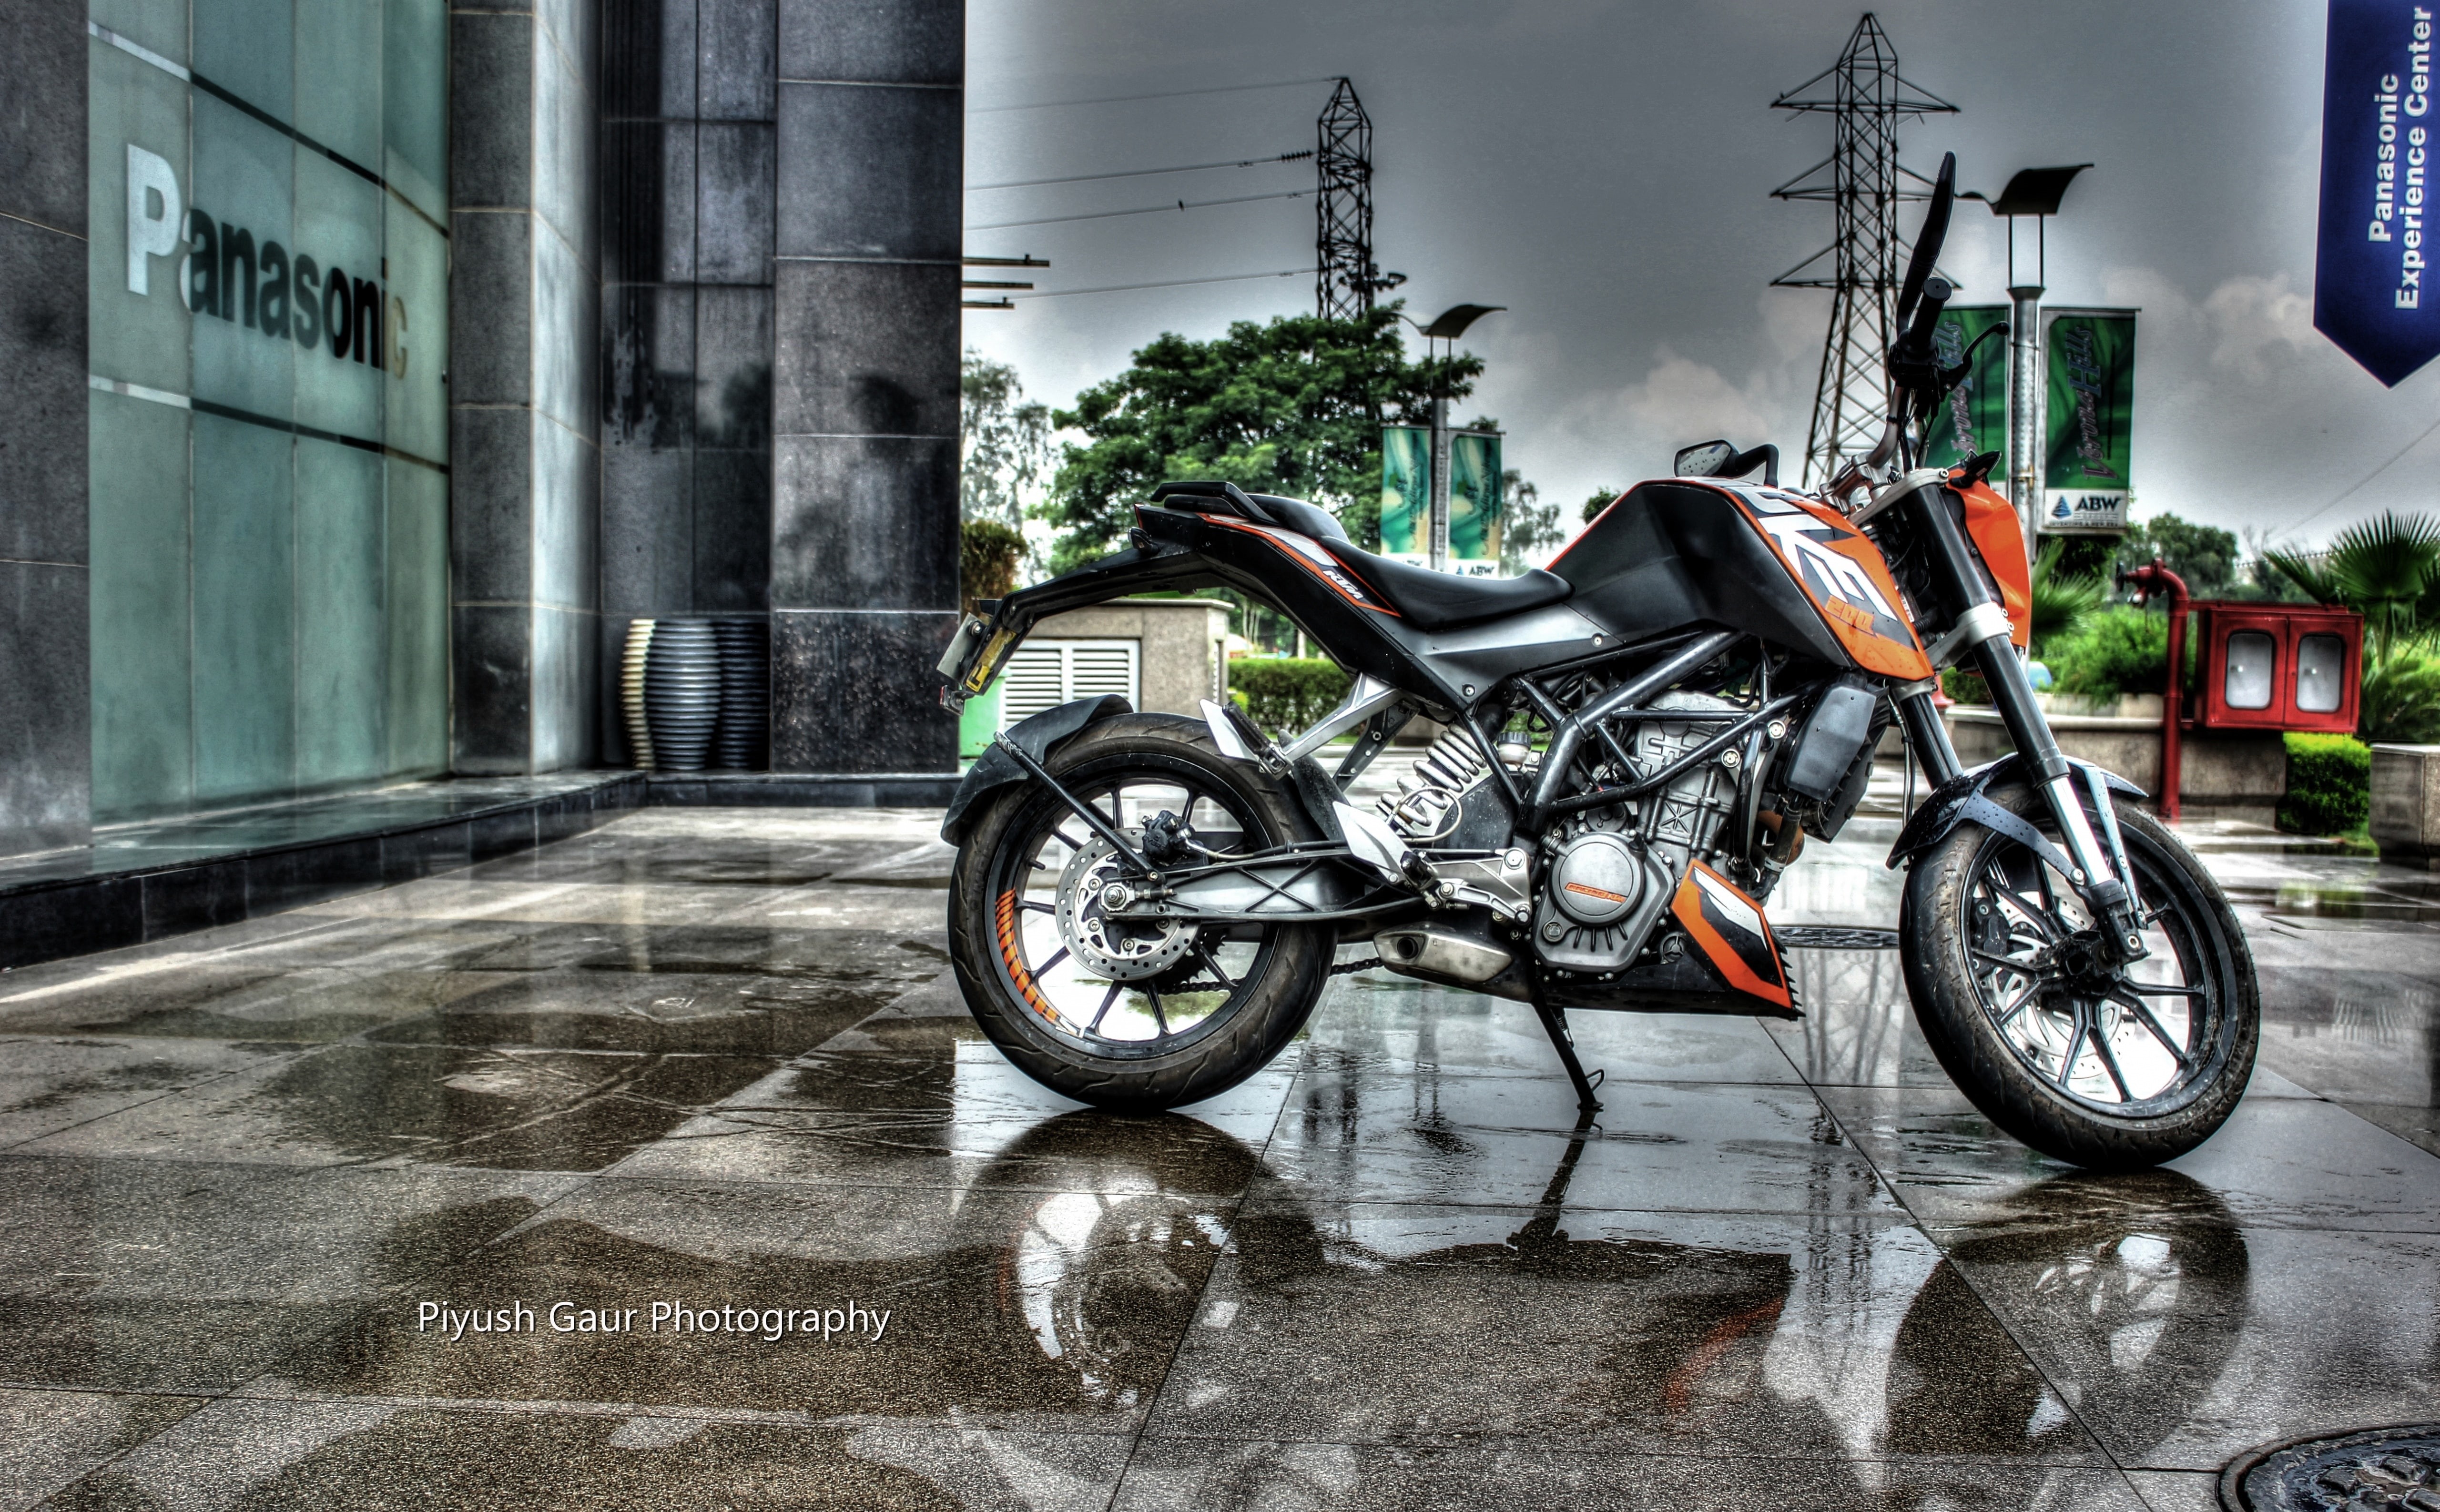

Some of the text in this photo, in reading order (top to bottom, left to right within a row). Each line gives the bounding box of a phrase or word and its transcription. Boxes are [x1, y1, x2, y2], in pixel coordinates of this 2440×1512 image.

[2367, 73, 2399, 243] Panasonic
[2394, 6, 2432, 310] Experience Center
[127, 143, 407, 380] Panasonic
[2064, 326, 2102, 398] Hills
[2074, 496, 2121, 511] ABW
[1322, 570, 1363, 599] KTM
[1469, 566, 1494, 576] ABW
[1825, 595, 1876, 636] 200
